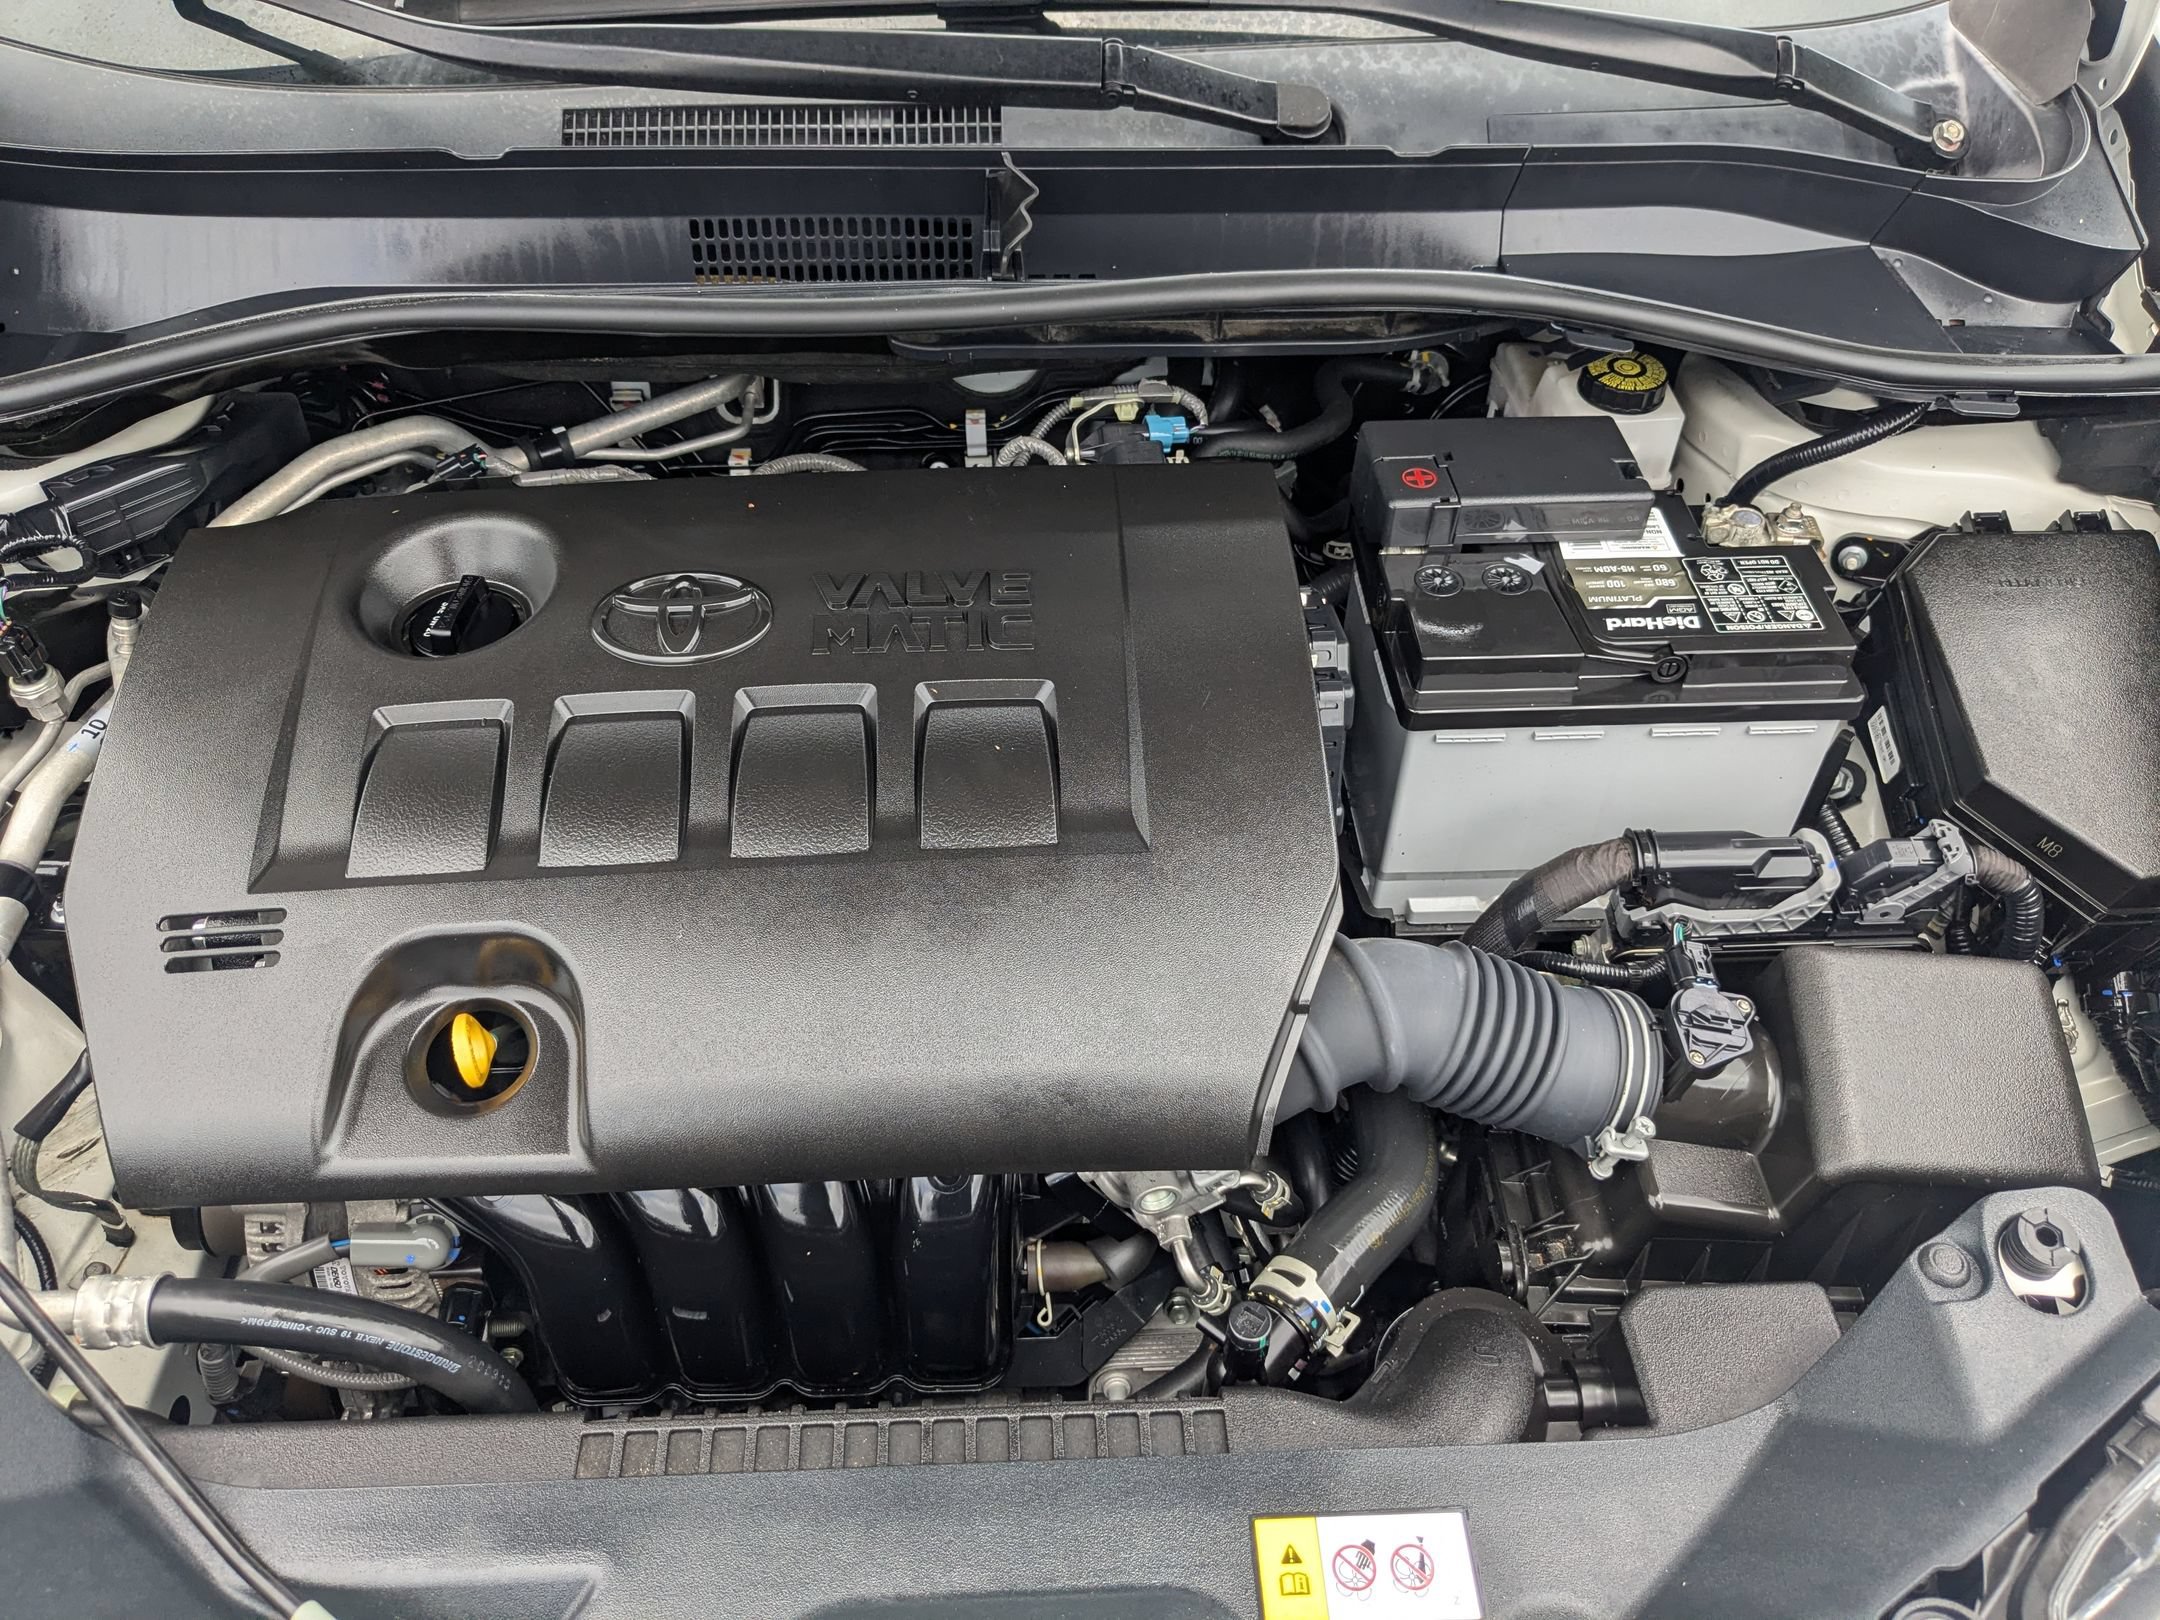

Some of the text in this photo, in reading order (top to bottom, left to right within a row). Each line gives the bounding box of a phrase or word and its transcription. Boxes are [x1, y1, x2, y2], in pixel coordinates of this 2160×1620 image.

[1606, 580, 1626, 588] 100
[1655, 578, 1676, 587] 680
[811, 570, 1033, 611] VALVE
[1588, 595, 1643, 603] PLATINUM
[1604, 616, 1701, 631] DieHard
[811, 611, 1035, 656] MATIC
[81, 719, 107, 739] 10
[2036, 836, 2064, 858] M8
[316, 1326, 338, 1336] SUC
[340, 1330, 352, 1339] 19
[386, 1340, 462, 1374] BRIDGESTONE
